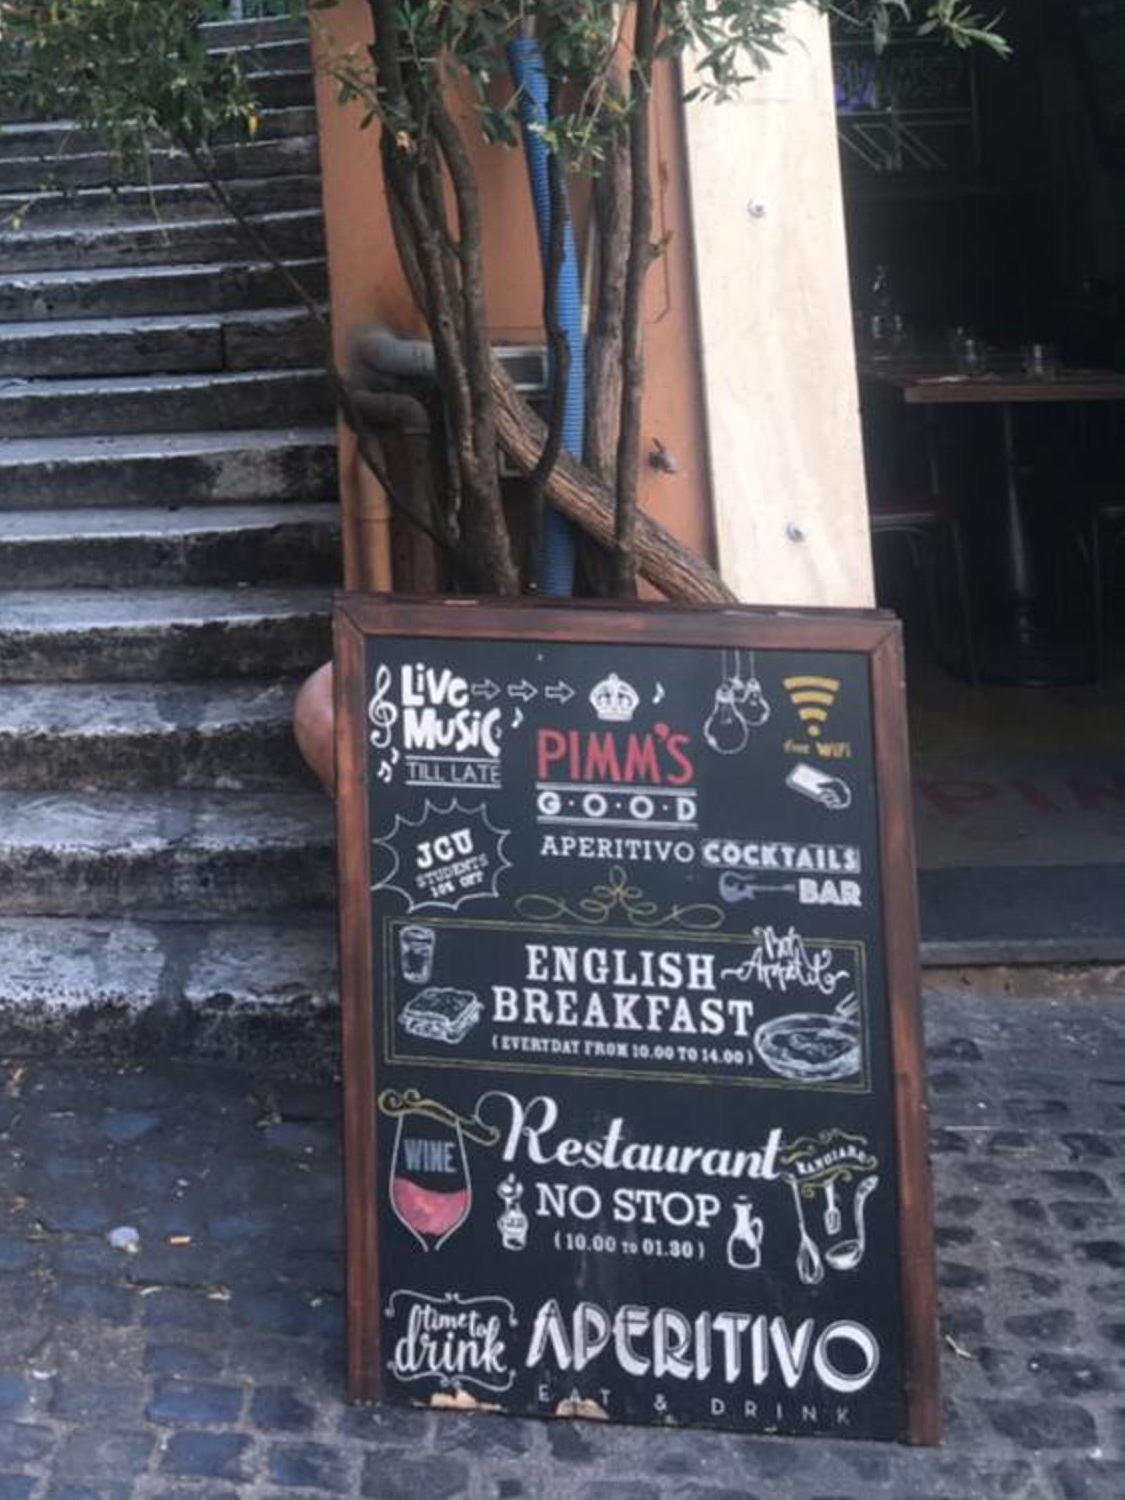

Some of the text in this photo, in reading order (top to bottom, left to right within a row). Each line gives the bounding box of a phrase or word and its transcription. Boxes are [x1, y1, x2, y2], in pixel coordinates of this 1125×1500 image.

[405, 761, 501, 784] TILL LATE
[537, 721, 694, 785] PIMM'S
[416, 827, 474, 869] JCU
[540, 835, 695, 863] APERITIVO
[702, 841, 856, 871] COCKTAILS
[416, 852, 489, 888] STUDENTS
[798, 877, 862, 907] BAR
[526, 944, 716, 990] ENGLISH
[491, 985, 754, 1036] BREAKFAST
[584, 1041, 629, 1058] FROM
[678, 1047, 698, 1062] TO
[403, 1139, 458, 1173] WINE
[476, 1090, 783, 1180] Restaurant
[535, 1182, 721, 1227] NO STOP
[395, 1303, 508, 1373] drink
[525, 1299, 880, 1393] APERITIVO
